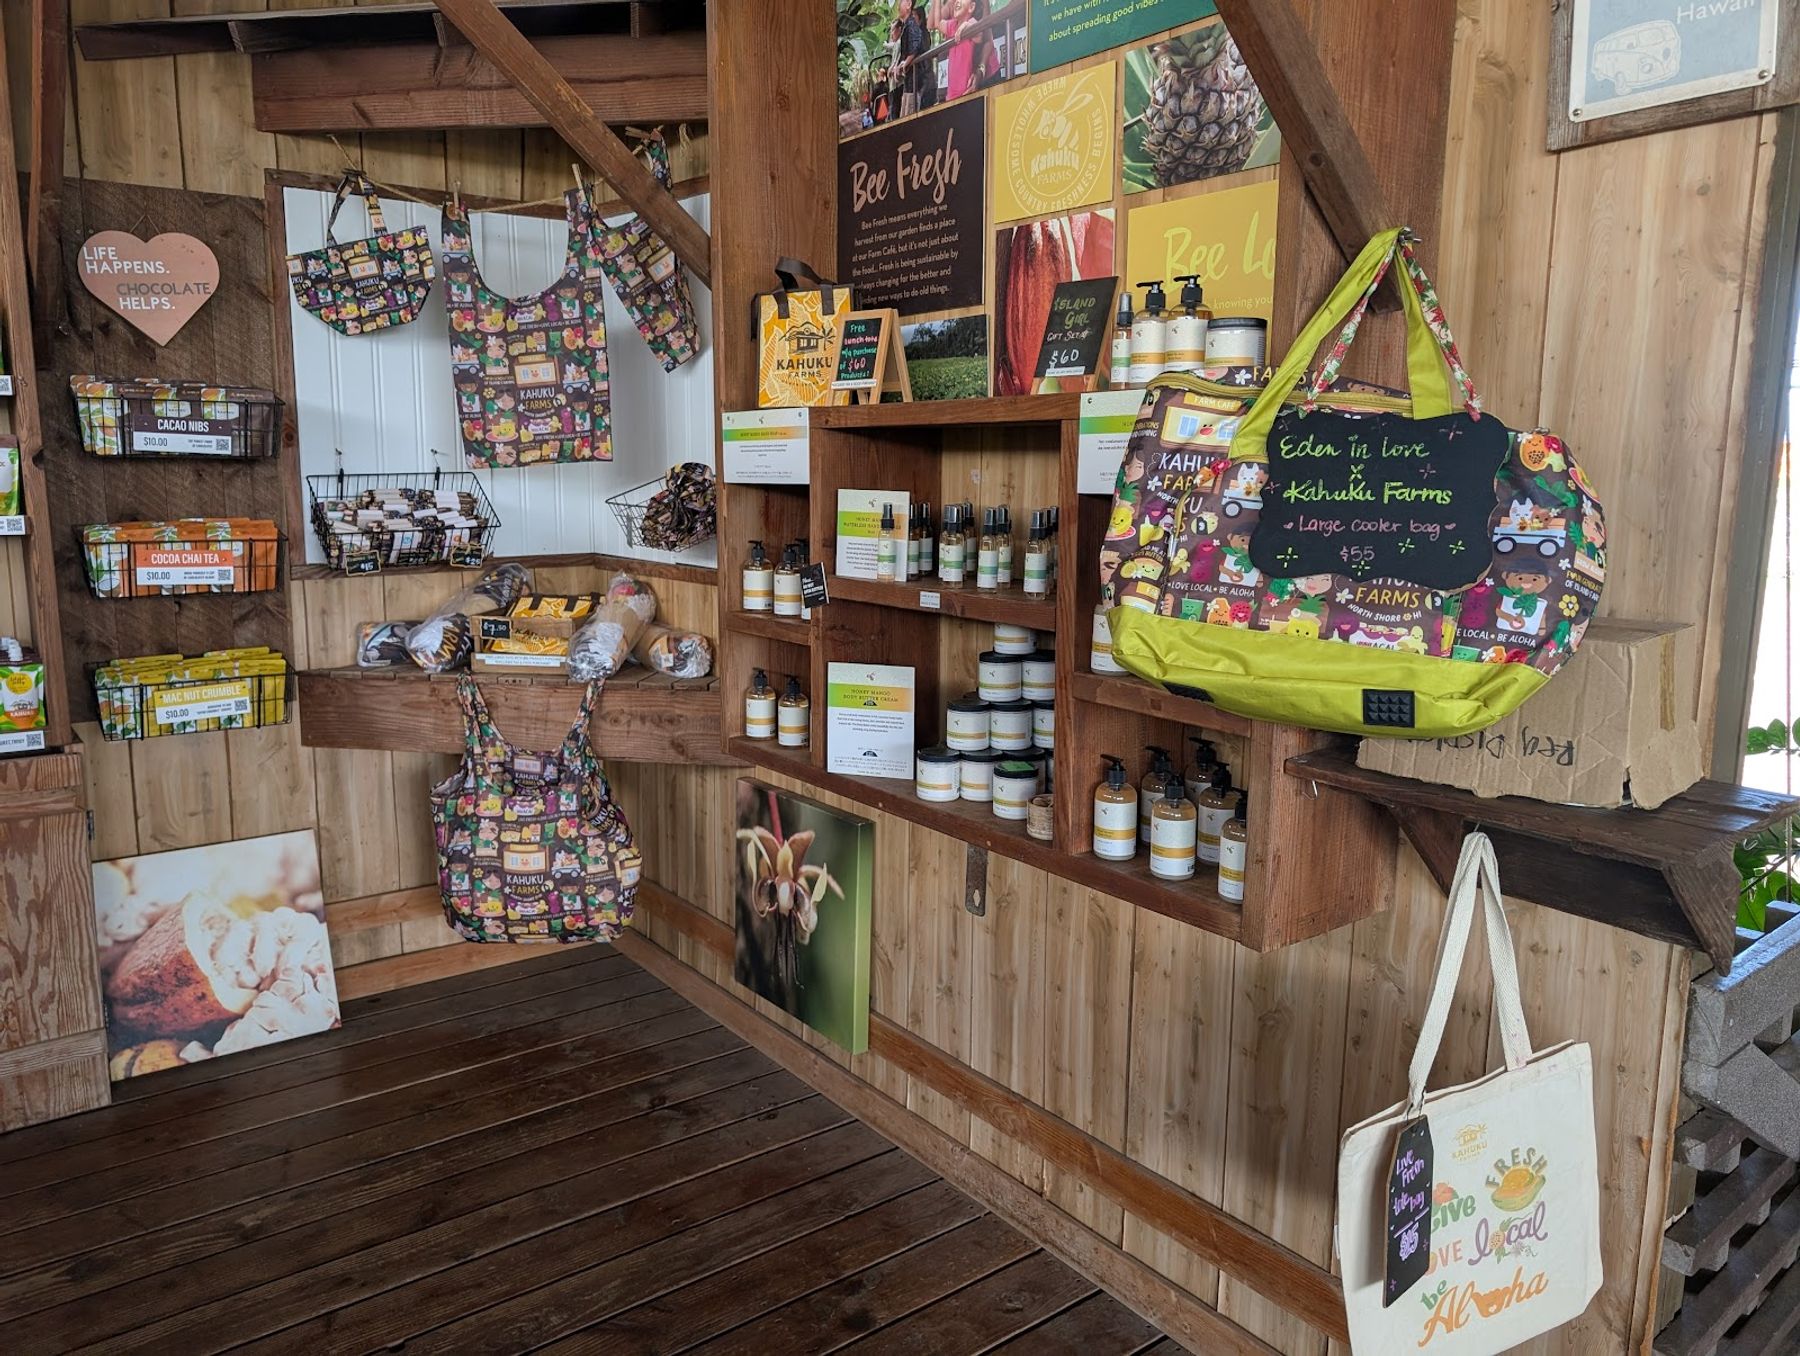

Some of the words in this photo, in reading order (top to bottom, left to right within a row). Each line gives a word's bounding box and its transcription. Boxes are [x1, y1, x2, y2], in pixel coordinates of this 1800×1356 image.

[1063, 6, 1082, 18] have
[1048, 27, 1072, 42] about
[1072, 14, 1111, 36] spreading
[1112, 4, 1134, 21] good
[850, 161, 891, 214] Bee
[896, 127, 963, 204] Fresh
[861, 220, 872, 231] Bee
[872, 216, 888, 227] Fresh
[888, 213, 907, 224] means
[906, 205, 938, 220] everything
[874, 232, 888, 243] from
[888, 231, 898, 239] our
[898, 225, 918, 239] garden
[918, 221, 934, 232] finds
[938, 217, 956, 229] place
[82, 246, 119, 260] LIFE
[867, 249, 882, 258] Farm
[897, 243, 908, 252] but
[908, 240, 918, 250] it's
[918, 239, 928, 248] not
[928, 236, 941, 248] just
[940, 232, 959, 243] about
[85, 260, 170, 275] HAPPENS.
[879, 262, 894, 272] Fresh
[894, 260, 900, 269] is
[900, 256, 917, 268] being
[917, 251, 950, 265] sustainable
[950, 249, 959, 260] by
[1163, 226, 1229, 294] Bee
[875, 276, 899, 288] changing
[900, 273, 909, 283] for
[909, 271, 919, 281] the
[919, 269, 939, 279] better
[939, 265, 952, 275] and
[116, 282, 211, 296] CHOCOLATE
[903, 289, 910, 298] to
[910, 287, 919, 296] do
[919, 285, 929, 295] old
[119, 296, 176, 310] HELPS.
[1213, 298, 1252, 311] knowing
[850, 323, 867, 333] Free
[776, 356, 833, 371] KAHUKU
[847, 356, 866, 373] $60
[1048, 348, 1080, 370] $60
[520, 386, 555, 400] KAHUKU
[525, 400, 553, 410] FARMS
[1194, 396, 1216, 408] FARM
[157, 418, 187, 432] CACAO
[188, 420, 209, 433] NIBS
[143, 436, 168, 448] $10.00
[1280, 433, 1342, 459] Eden
[1348, 434, 1371, 459] in
[1156, 491, 1179, 504] NORTH
[1383, 481, 1453, 505] Farms
[1351, 517, 1402, 534] cooler
[1409, 519, 1440, 542] bag
[151, 553, 180, 564] COCOA
[182, 553, 202, 564] CHAI
[203, 553, 220, 564] TEA
[1339, 545, 1375, 562] $55
[146, 571, 171, 581] $10.00
[1171, 580, 1189, 591] LOVE
[1190, 583, 1213, 592] LOCAL
[1219, 587, 1228, 595] BE
[1230, 587, 1255, 598] ALOHA
[1355, 587, 1421, 609] FARMS
[1347, 603, 1372, 618] NORTH
[1375, 612, 1401, 623] SHORE
[1413, 610, 1422, 619] HI
[1463, 629, 1490, 641] LOCAL
[1497, 633, 1509, 642] BE
[1510, 634, 1536, 648] ALOHA
[162, 692, 182, 704] MAC
[183, 690, 200, 701] NUT
[202, 684, 241, 699] CRUMBLE
[165, 708, 189, 720] $10.00
[506, 874, 544, 885] KAHUKU
[511, 885, 540, 894] FARMS
[1451, 1141, 1488, 1160] KAHUKU
[1484, 1146, 1548, 1189] FRESH
[1420, 1279, 1447, 1311] be
